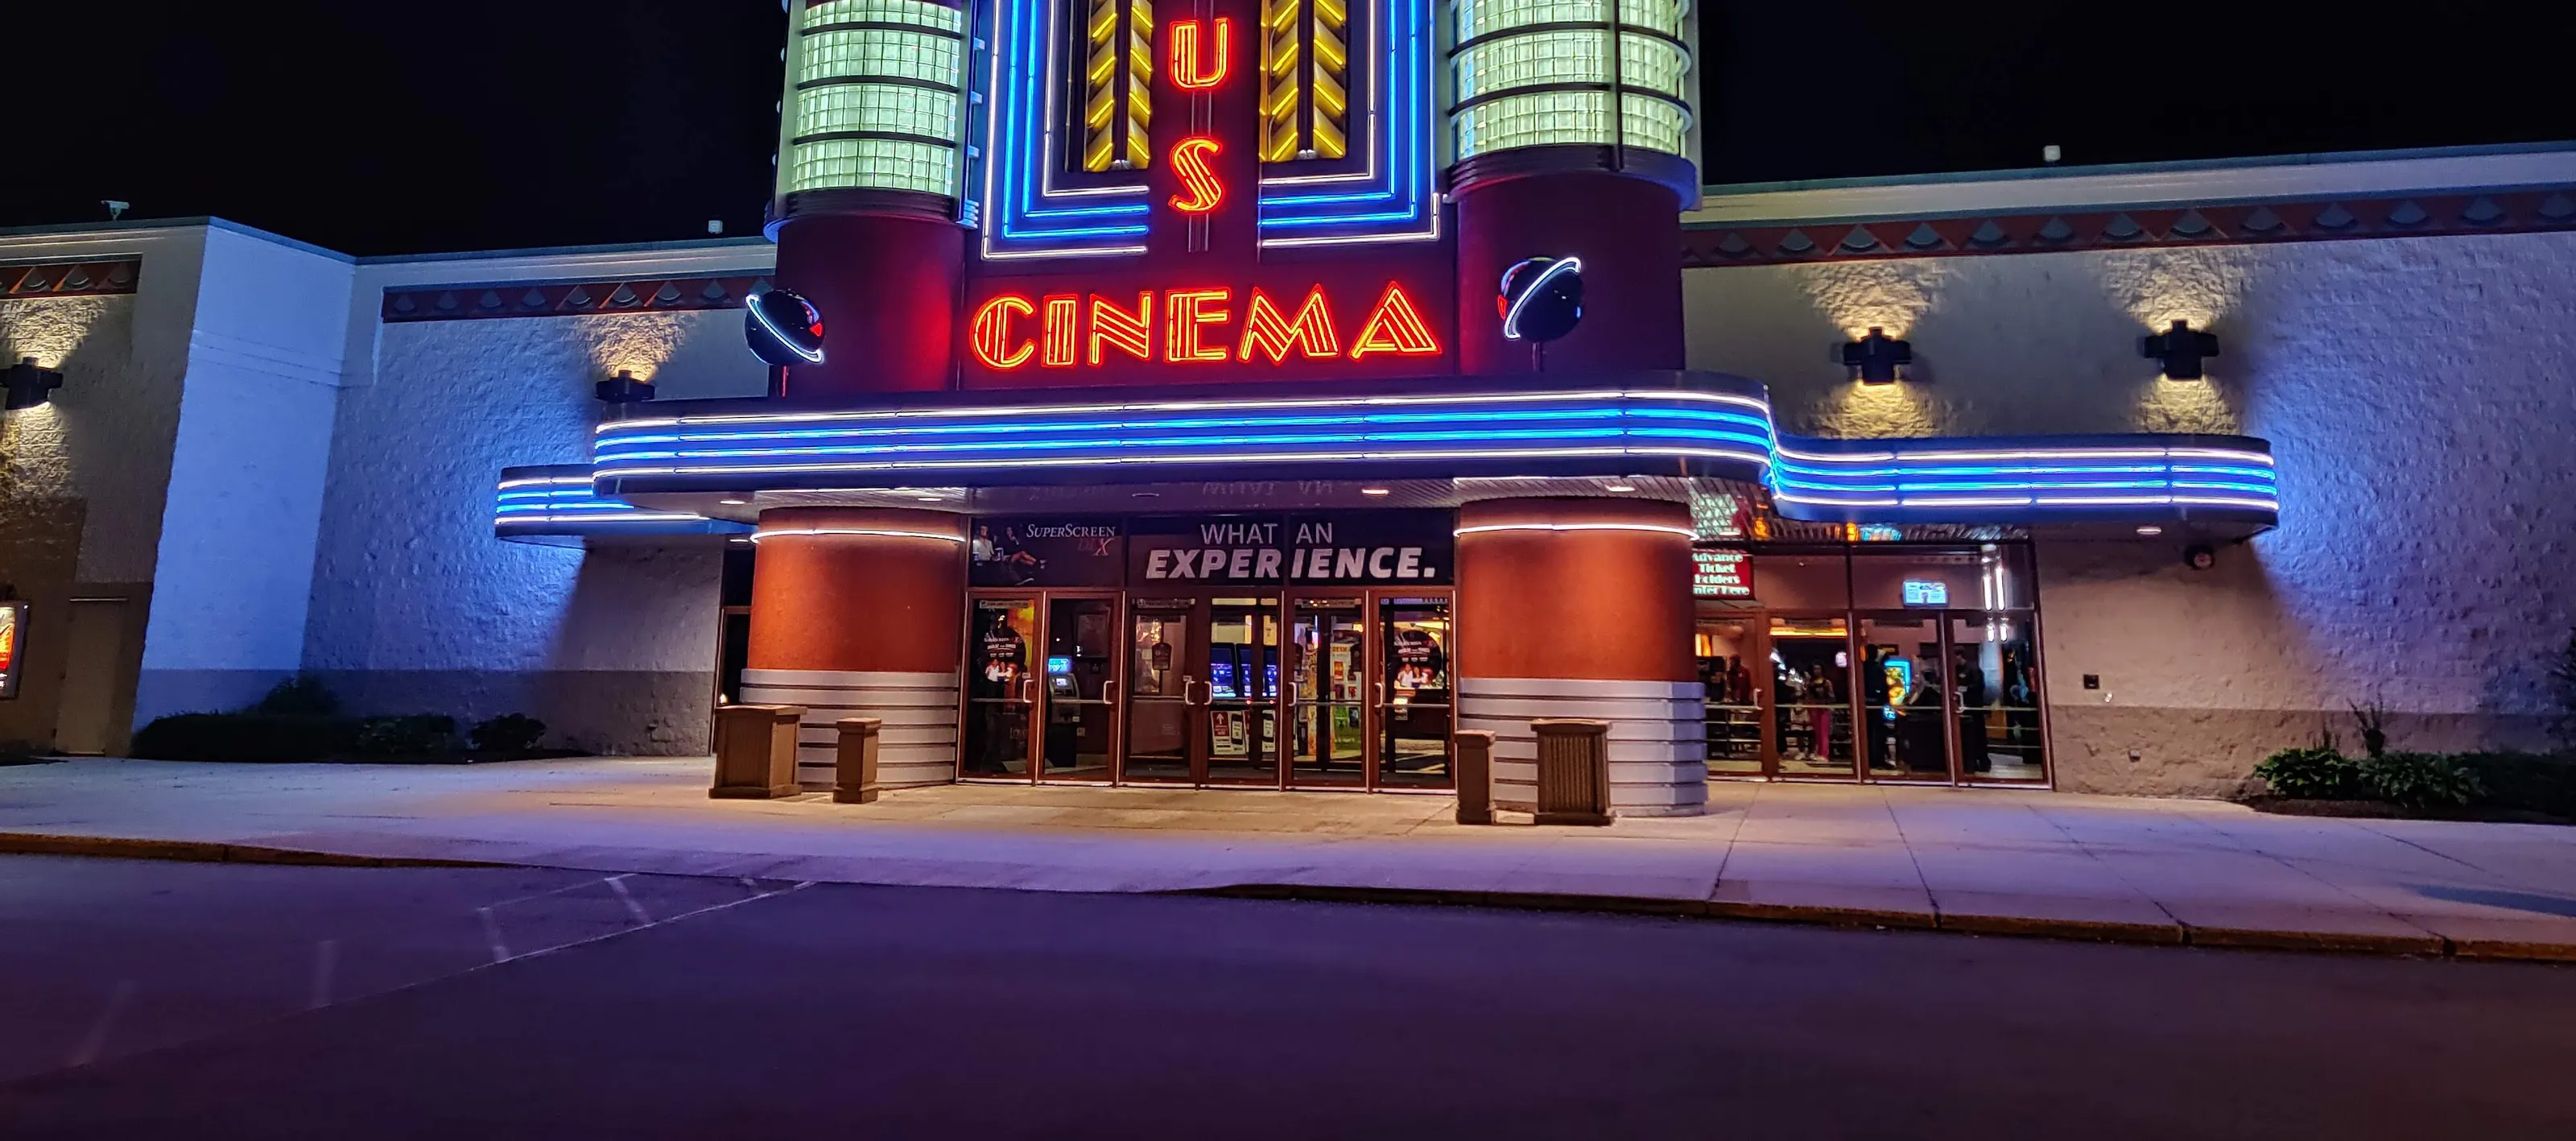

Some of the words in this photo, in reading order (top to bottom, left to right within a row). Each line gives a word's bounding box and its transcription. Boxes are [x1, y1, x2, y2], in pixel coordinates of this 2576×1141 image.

[970, 281, 1441, 369] CINEMA
[1200, 523, 1278, 544] WHAT
[1296, 523, 1332, 544] AN
[1692, 552, 1744, 562] Advance
[1698, 564, 1736, 573] Ticket
